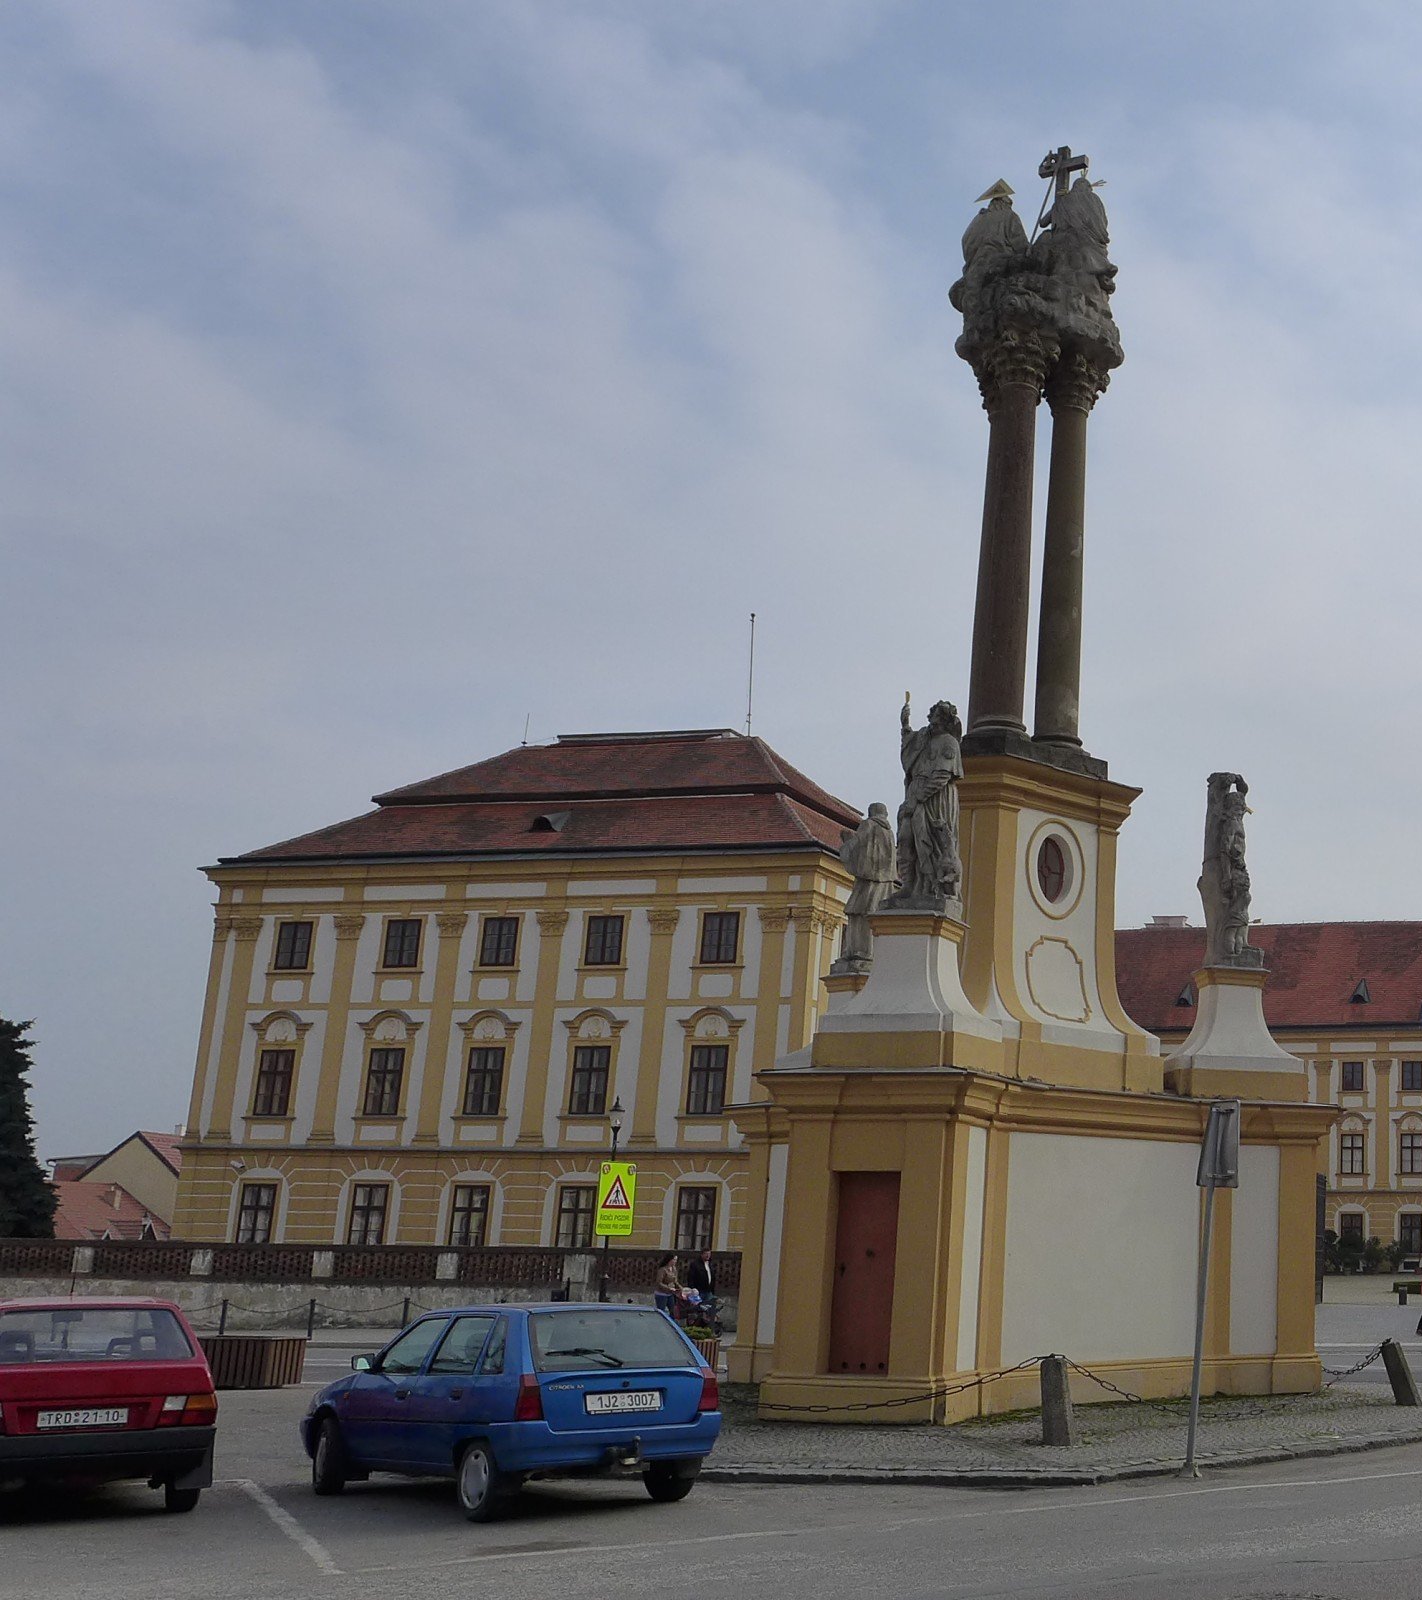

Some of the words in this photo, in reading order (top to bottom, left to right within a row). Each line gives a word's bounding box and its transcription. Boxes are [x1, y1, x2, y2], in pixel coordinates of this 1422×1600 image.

[597, 1395, 619, 1408] 1J2
[627, 1393, 655, 1407] 3007
[82, 1410, 120, 1423] 21-10
